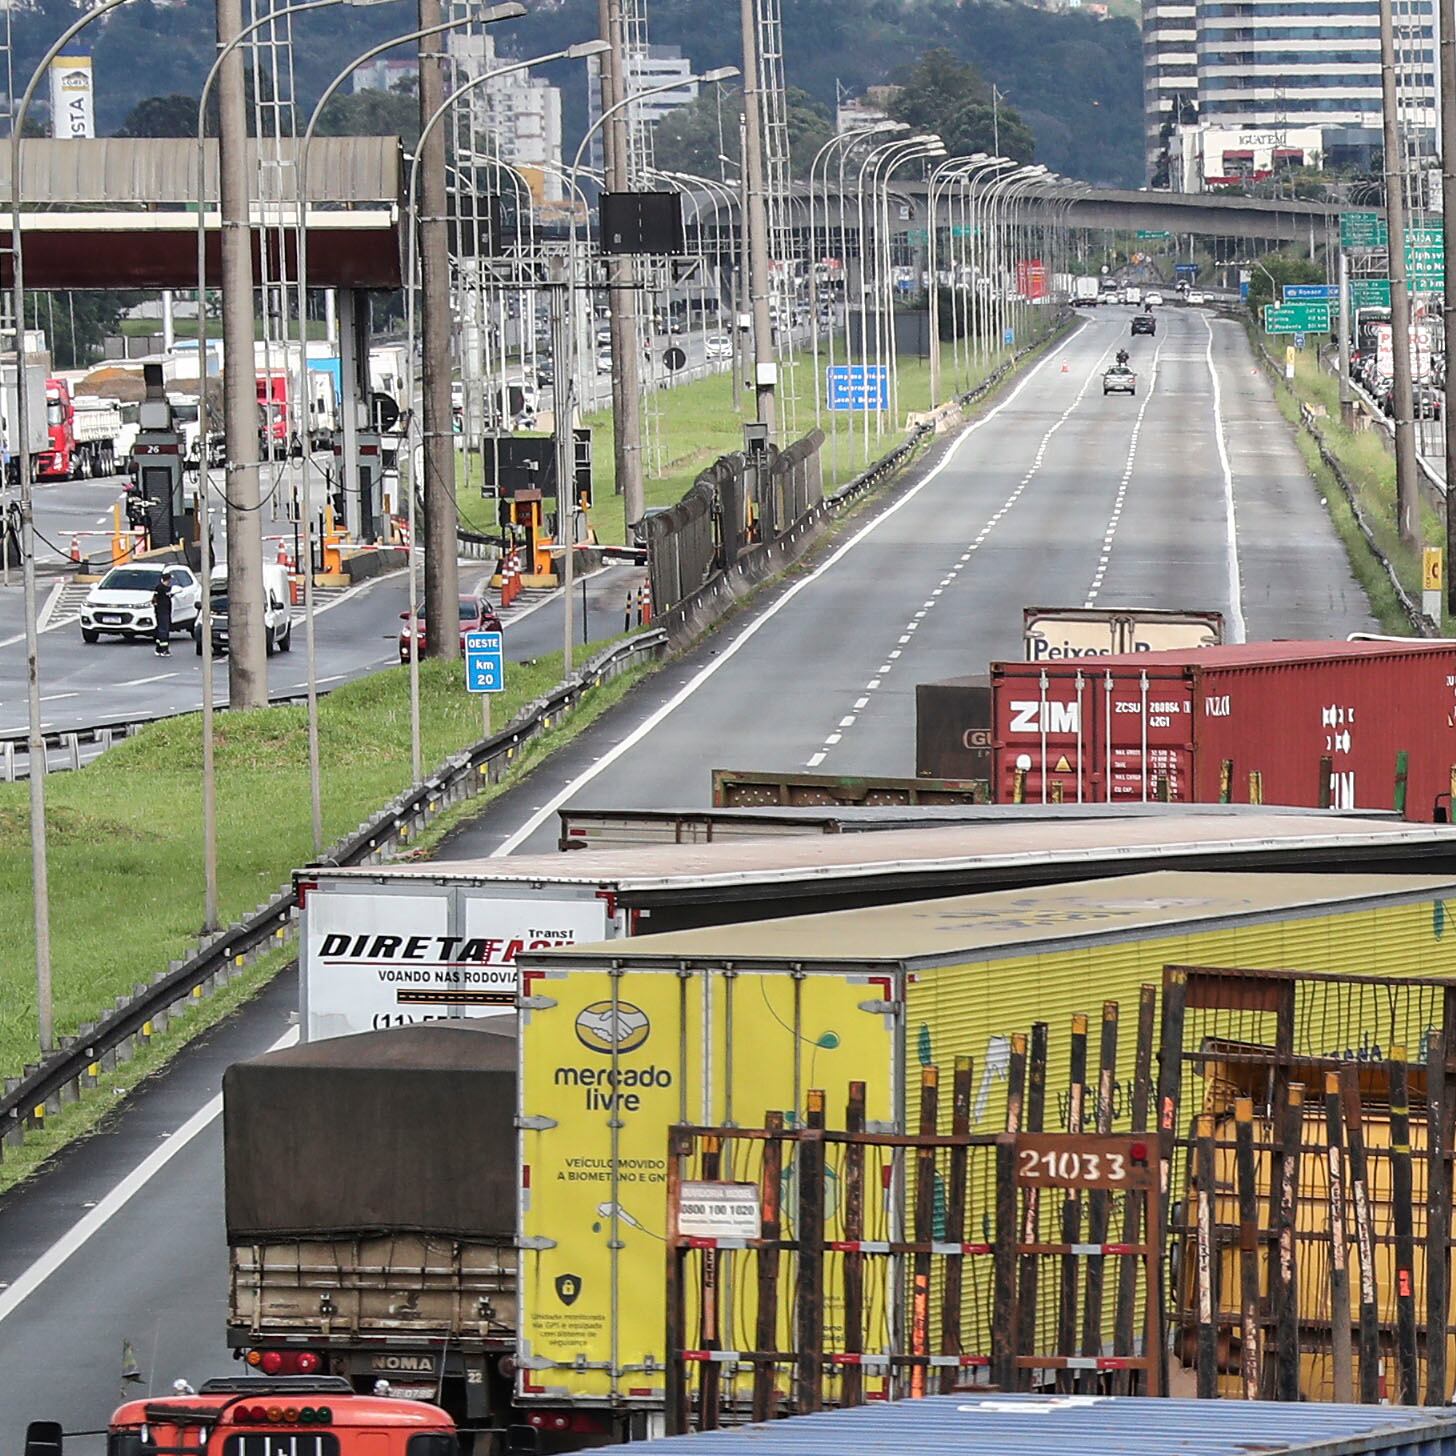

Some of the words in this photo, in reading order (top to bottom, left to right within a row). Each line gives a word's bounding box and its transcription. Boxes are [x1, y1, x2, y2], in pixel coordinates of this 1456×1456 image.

[1239, 134, 1287, 145] IGUATEMI
[147, 445, 160, 454] 26
[468, 638, 499, 649] OESTE
[1034, 640, 1110, 661] Peixes
[475, 659, 495, 670] km
[477, 673, 494, 685] 20
[1115, 702, 1141, 713] ZCSU
[1010, 702, 1080, 732] ZIM
[378, 970, 431, 983] VOANDO
[434, 971, 461, 984] NAS
[554, 1065, 673, 1088] mercado
[586, 1087, 641, 1111] livre
[618, 1159, 665, 1170] MOVIDO
[1019, 1149, 1126, 1181] 21033
[557, 1173, 565, 1181] A
[640, 1174, 646, 1182] E
[371, 1356, 434, 1371] NOMA
[467, 1371, 483, 1384] 22
